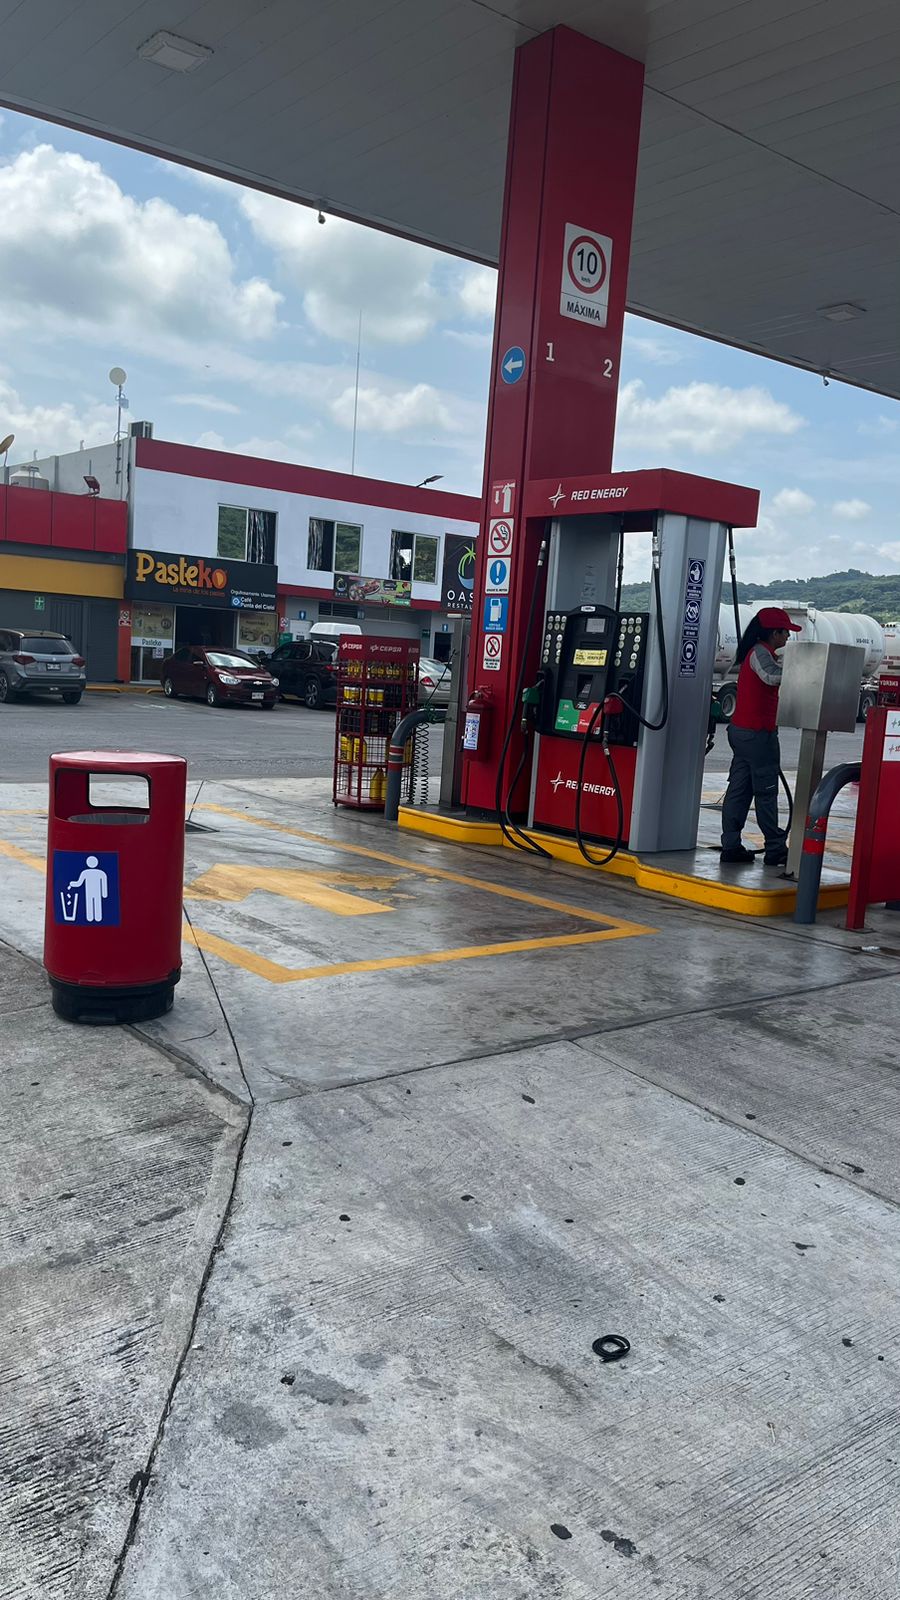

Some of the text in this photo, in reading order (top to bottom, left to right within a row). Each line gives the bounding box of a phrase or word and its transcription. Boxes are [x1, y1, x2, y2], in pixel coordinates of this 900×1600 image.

[577, 248, 598, 276] 10
[566, 301, 601, 321] MÁXIMA
[546, 342, 555, 362] 1
[603, 358, 613, 378] 2
[571, 487, 629, 501] RED ENERGY
[135, 552, 227, 589] Pasteko
[379, 645, 402, 653] CEPSA
[582, 782, 616, 797] ENERGY
